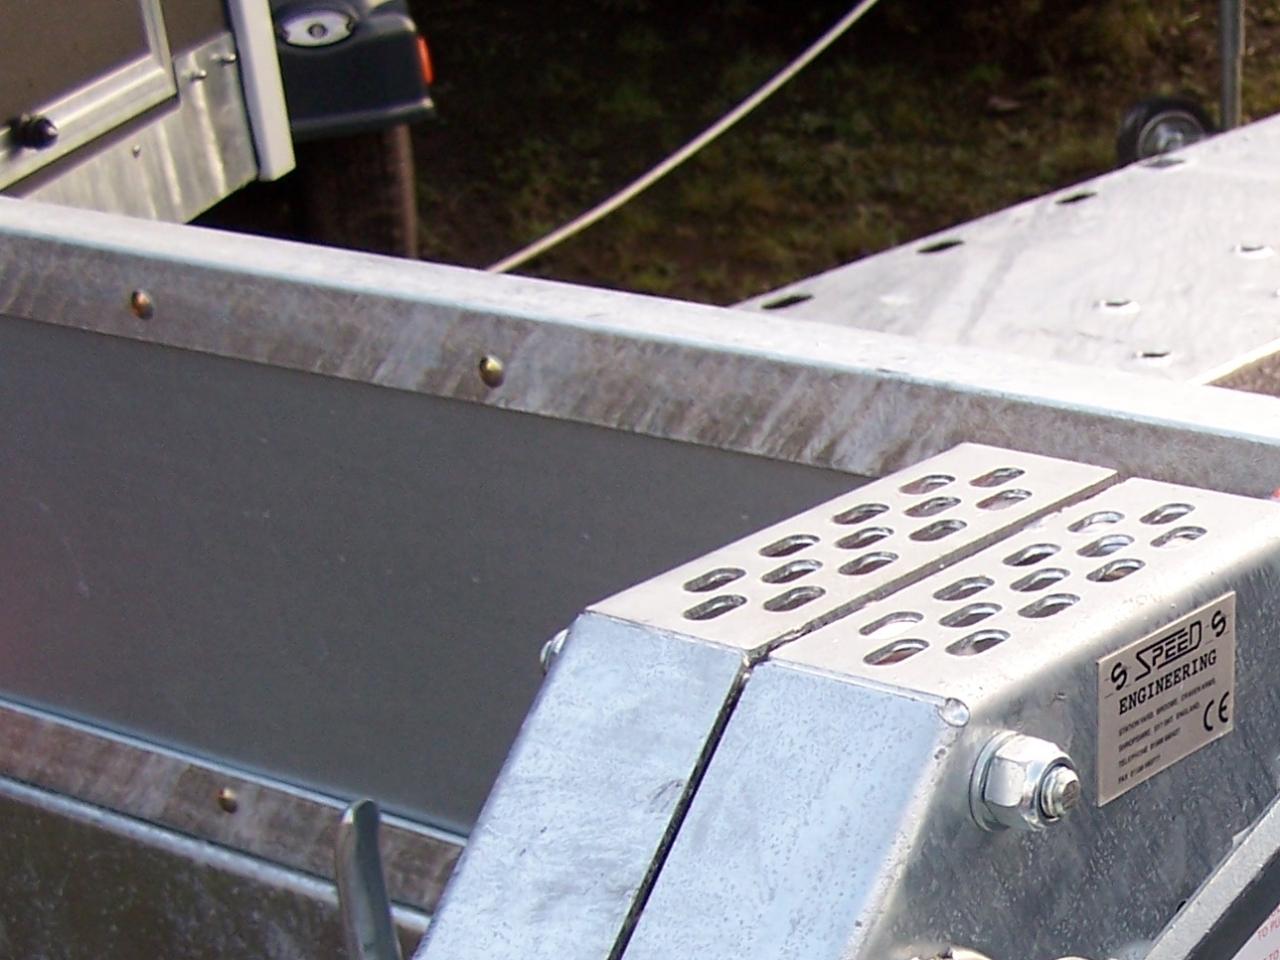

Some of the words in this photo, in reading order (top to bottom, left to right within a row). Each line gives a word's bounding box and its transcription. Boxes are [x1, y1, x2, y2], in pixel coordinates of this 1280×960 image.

[1135, 620, 1202, 681] SPEED
[1119, 649, 1217, 715] ENGINEERING
[1203, 691, 1230, 732] CE
[1257, 926, 1269, 941] TO
